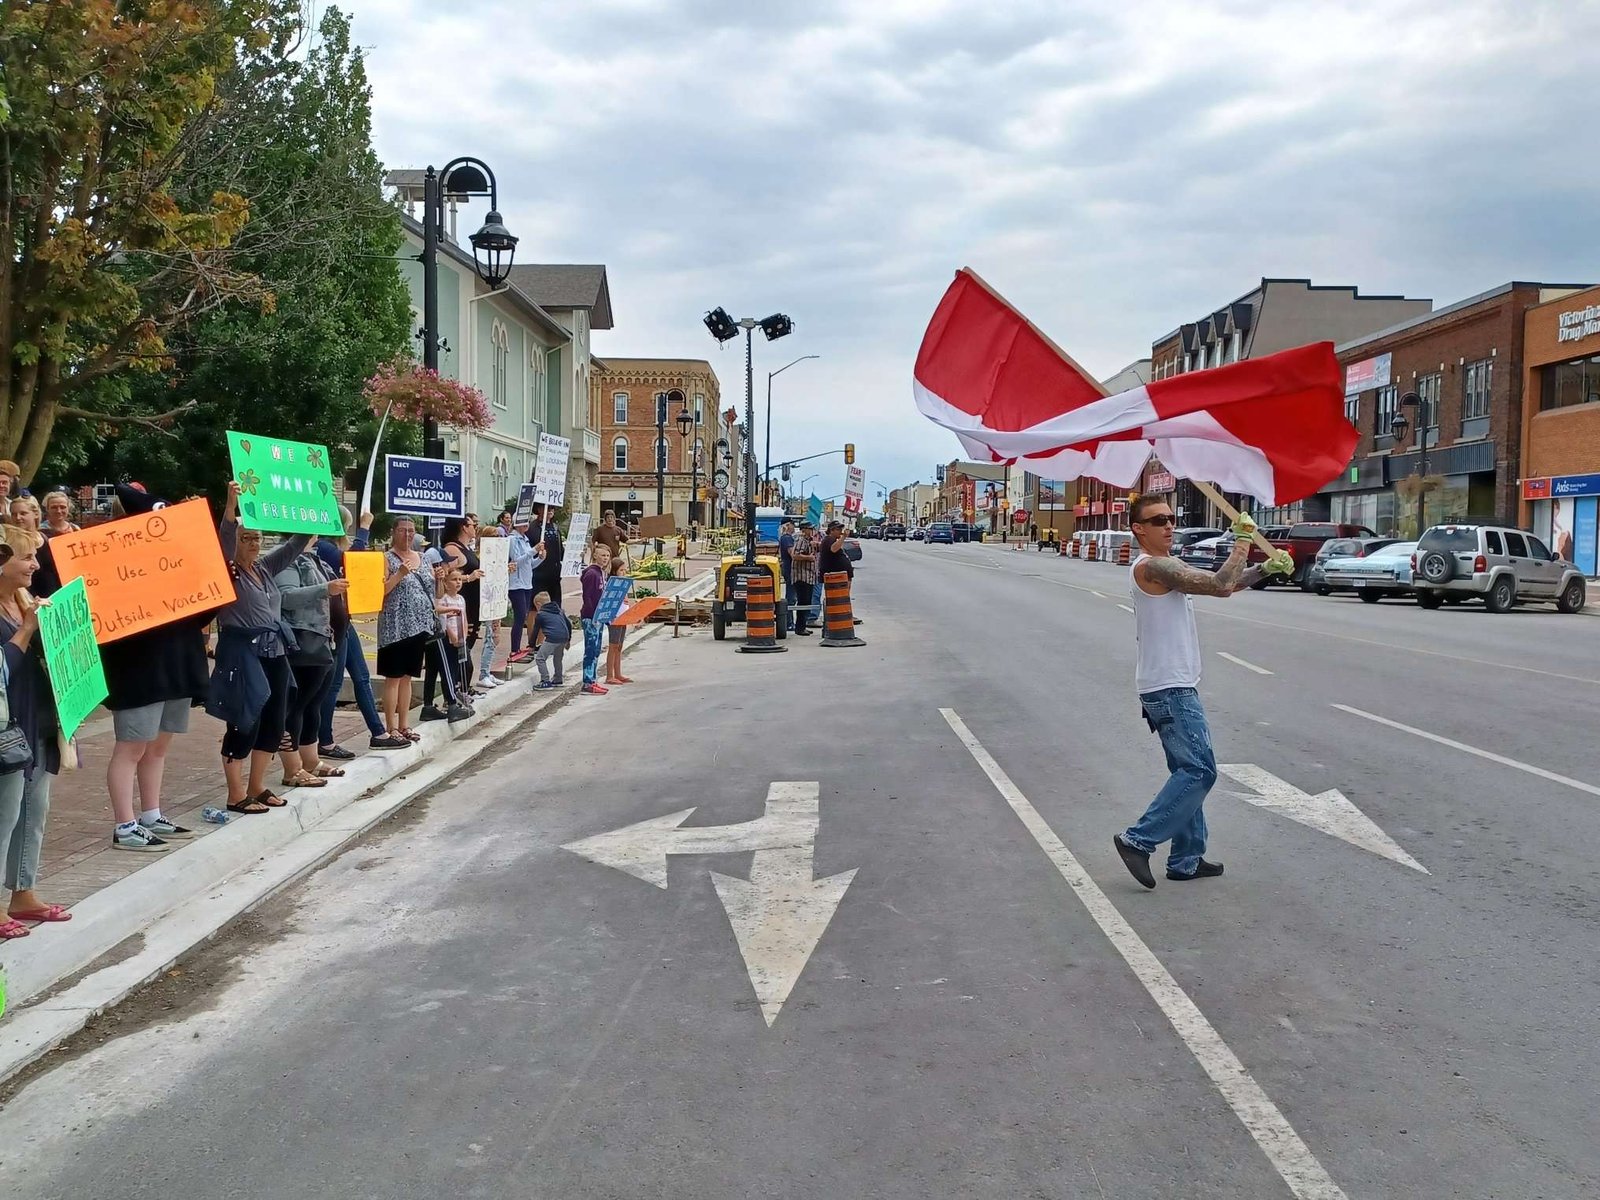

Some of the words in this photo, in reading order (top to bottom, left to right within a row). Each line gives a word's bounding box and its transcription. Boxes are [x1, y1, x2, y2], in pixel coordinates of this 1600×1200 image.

[1559, 305, 1595, 328] Victoria
[1558, 327, 1580, 343] Drug
[270, 444, 295, 463] WE
[392, 461, 410, 469] ELECT
[443, 464, 460, 475] PPC
[270, 473, 313, 495] WANT
[407, 478, 444, 490] ALISON
[1555, 480, 1570, 493] Axis
[397, 487, 453, 501] DAVIDSON
[548, 489, 563, 505] PPC
[261, 501, 330, 524] FREEDOM
[106, 529, 144, 546] Time
[117, 565, 147, 582] Use
[158, 556, 184, 572] Our
